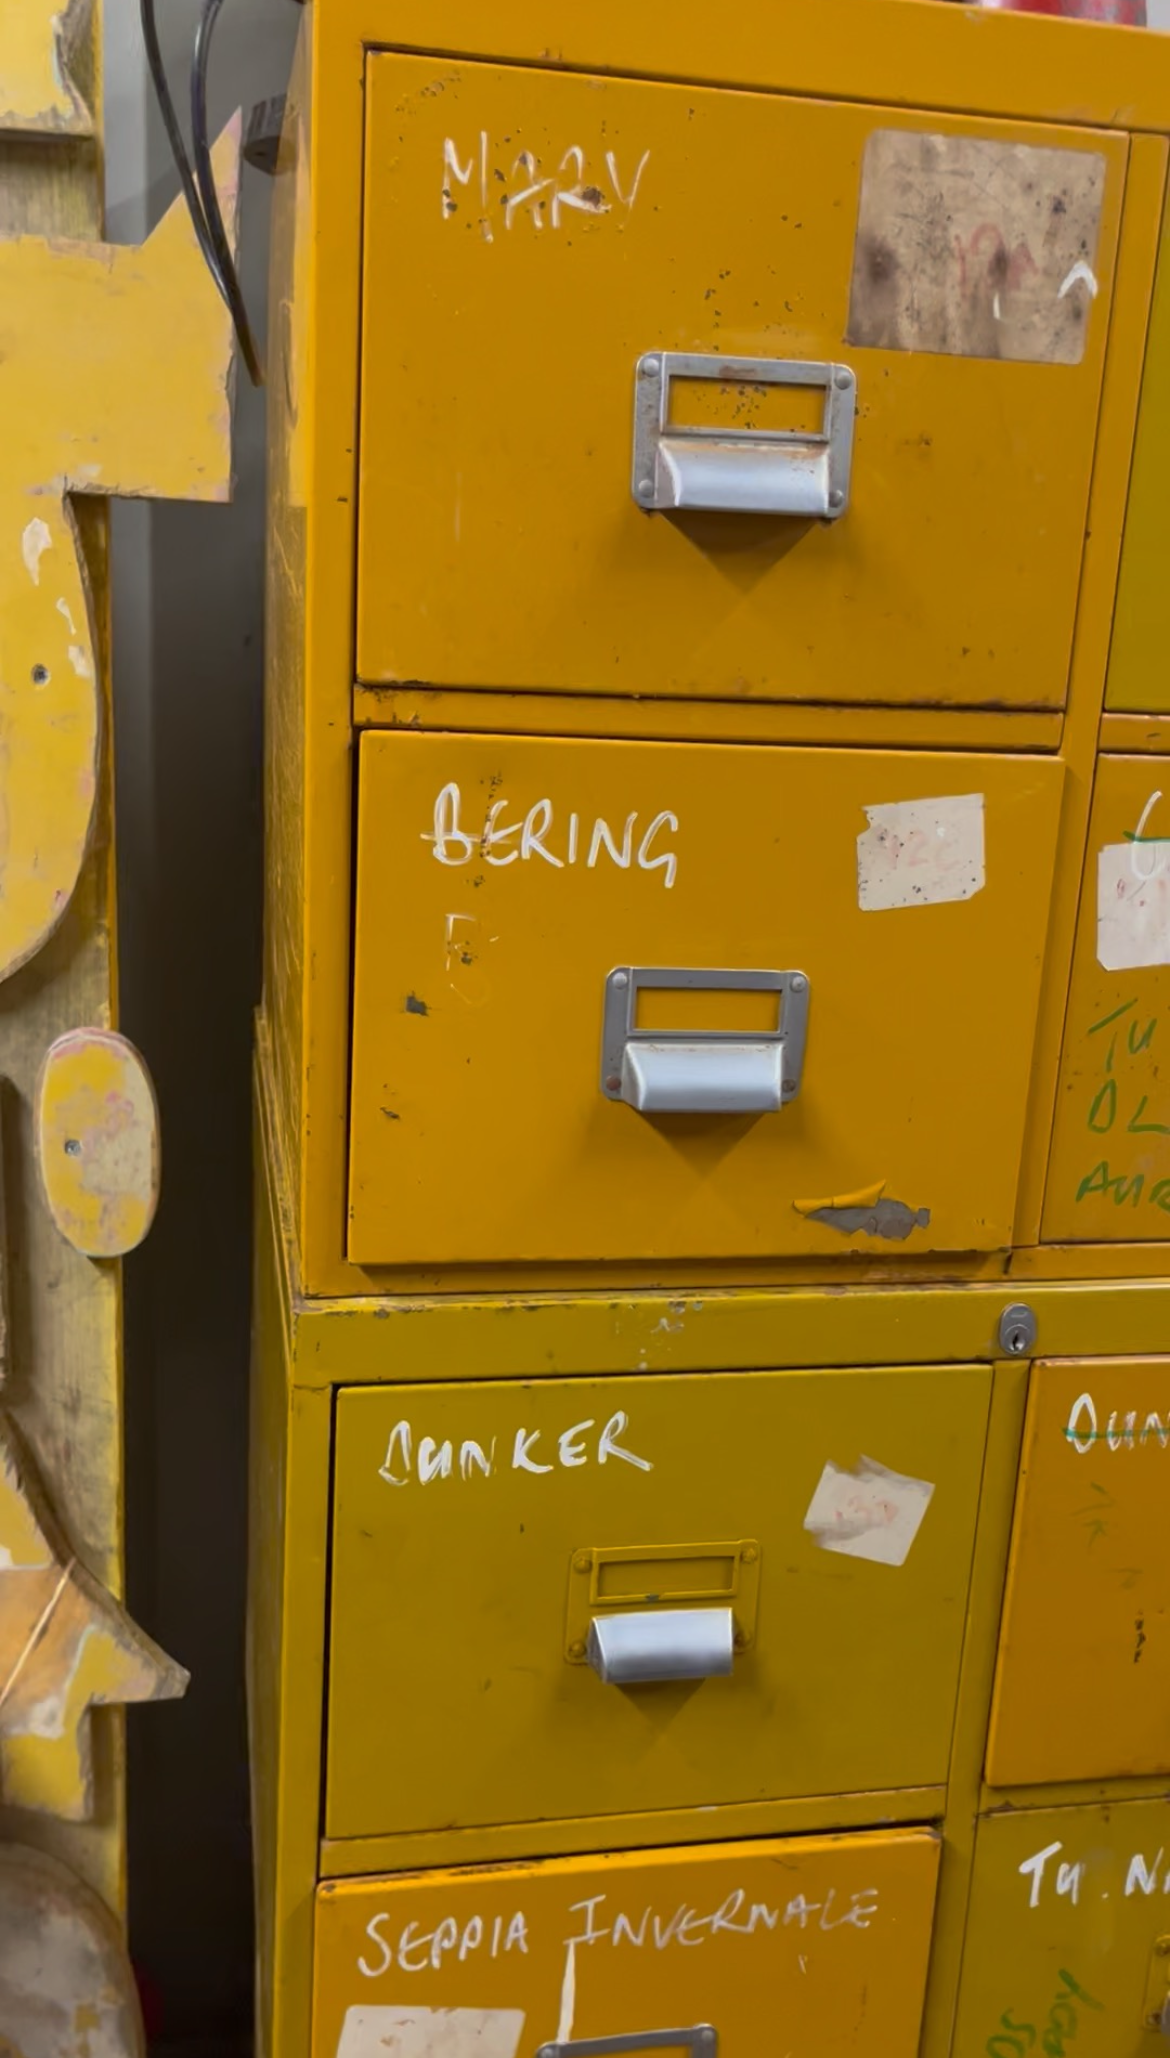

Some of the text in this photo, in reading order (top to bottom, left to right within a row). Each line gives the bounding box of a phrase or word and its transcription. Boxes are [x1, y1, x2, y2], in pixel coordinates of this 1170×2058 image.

[420, 782, 679, 888] BERING
[356, 1888, 879, 1978] SEPPIA INVERNALE
